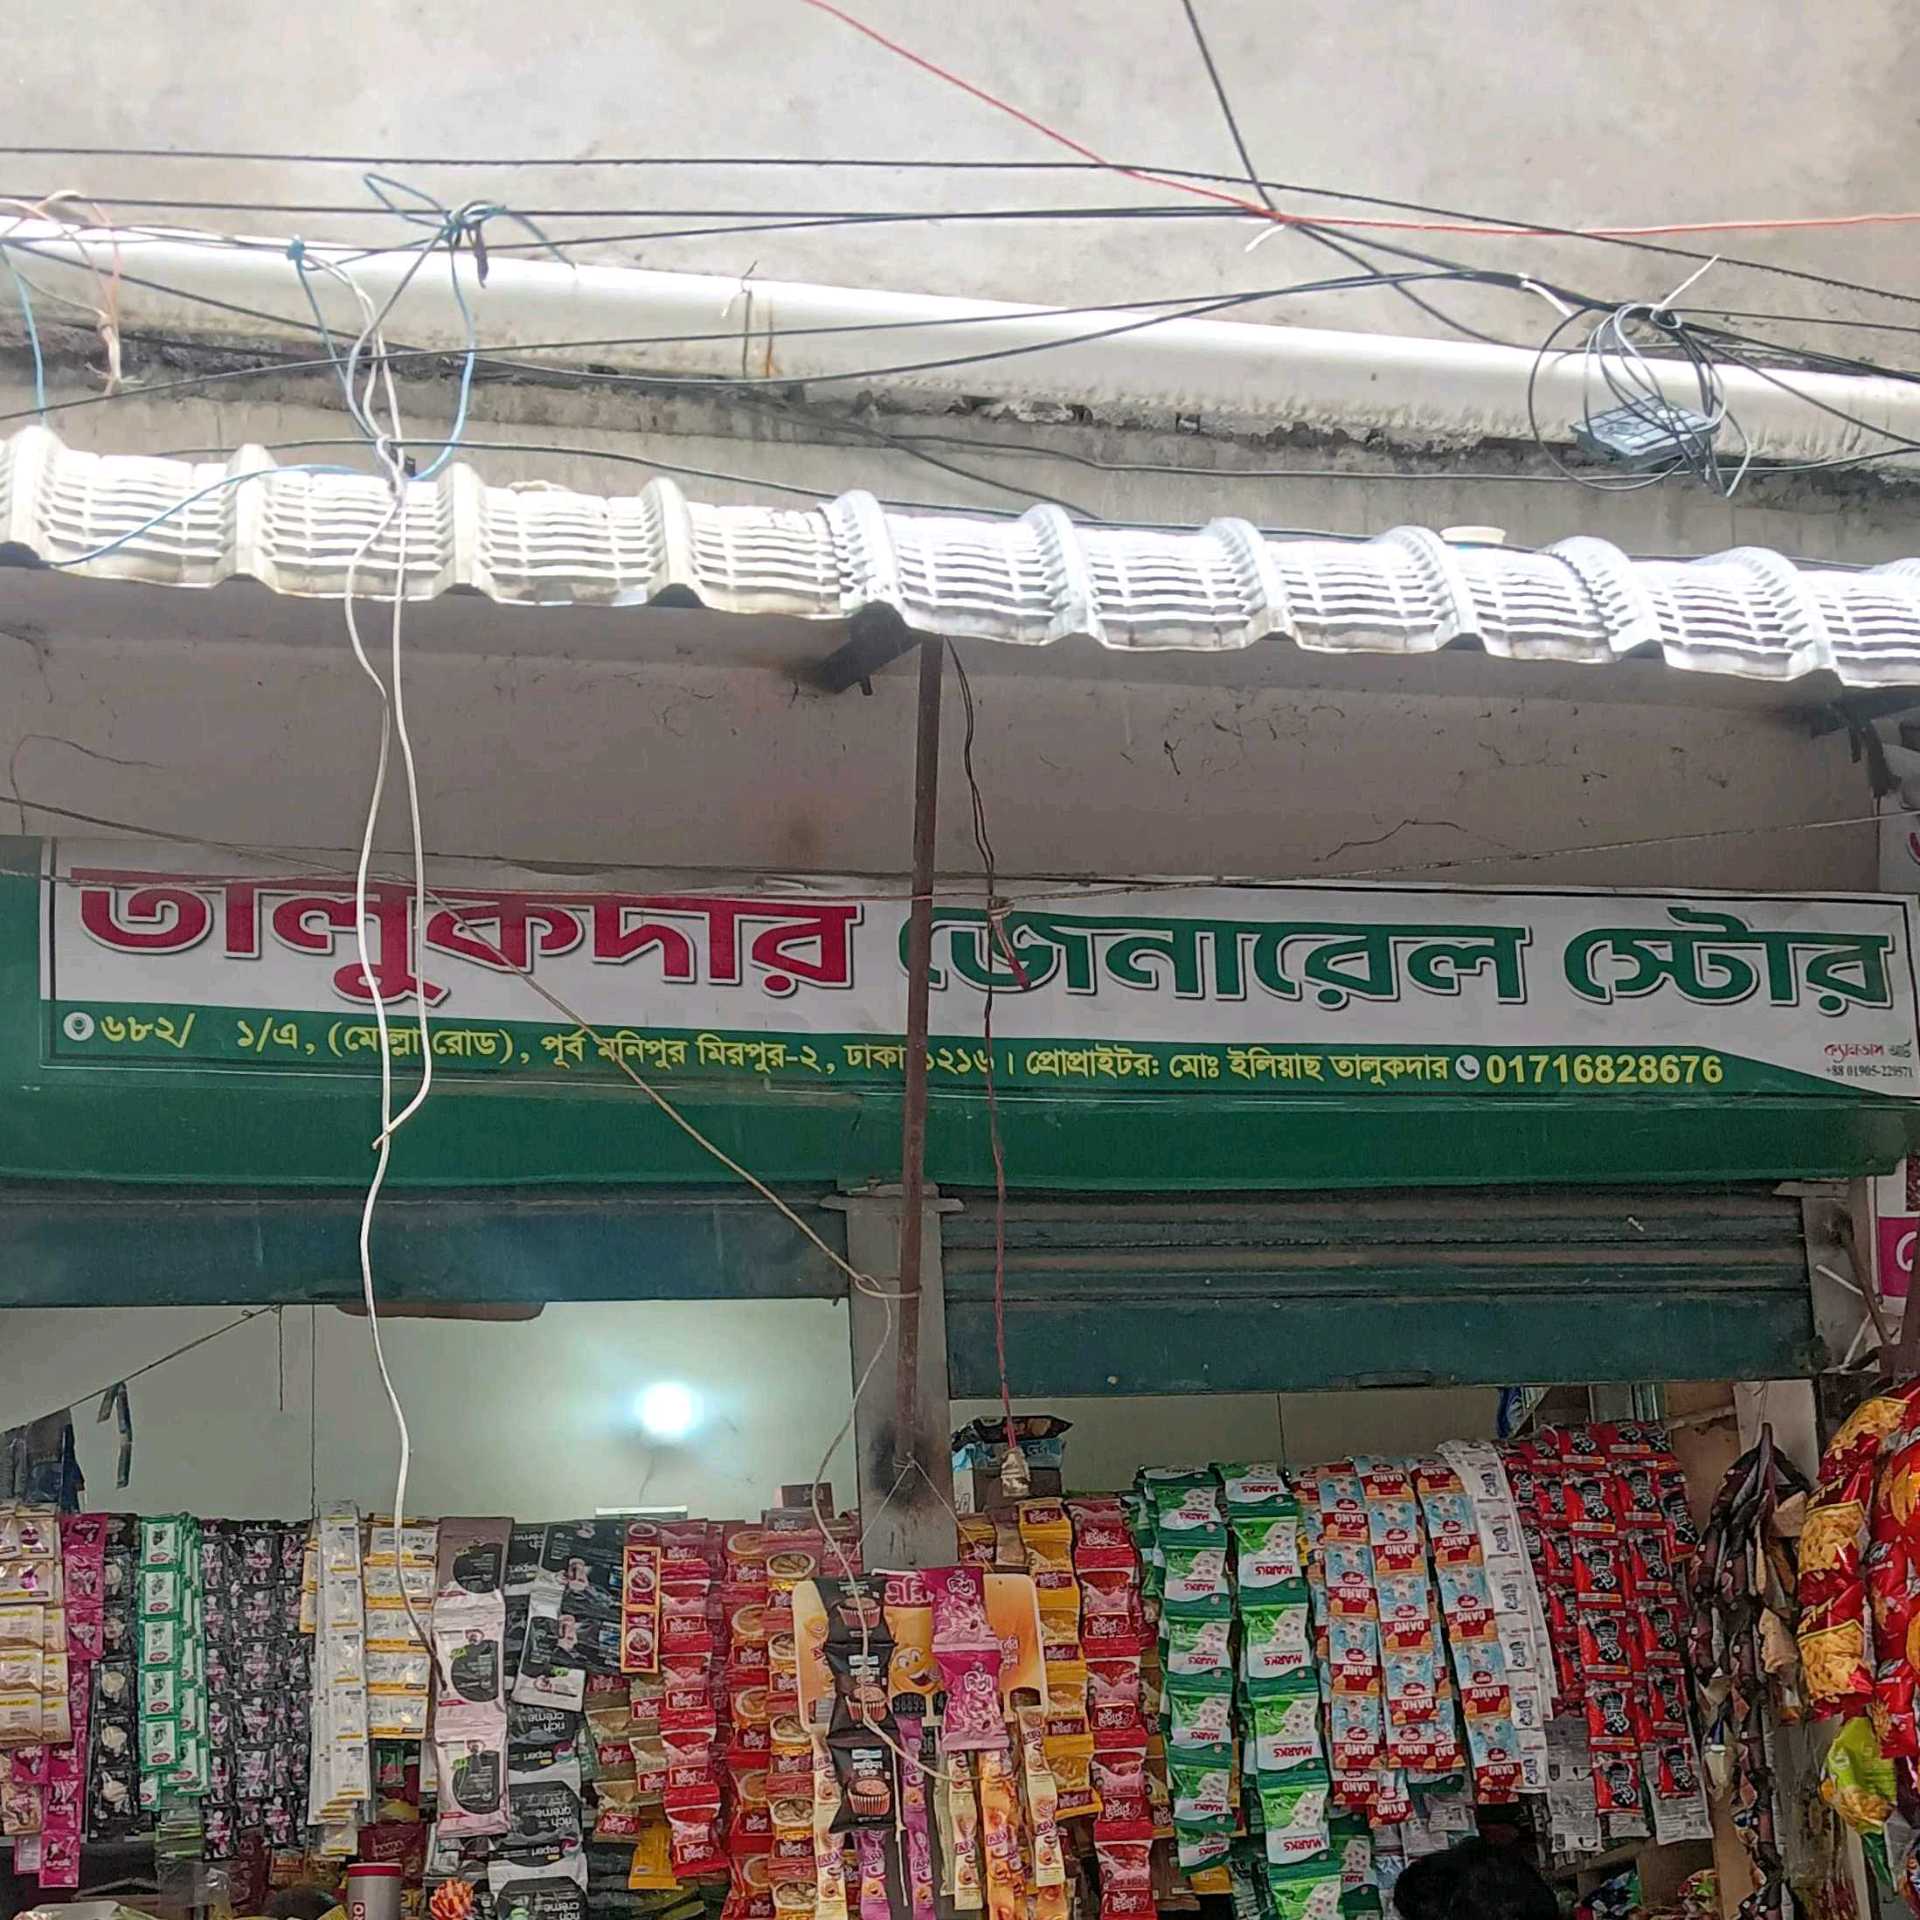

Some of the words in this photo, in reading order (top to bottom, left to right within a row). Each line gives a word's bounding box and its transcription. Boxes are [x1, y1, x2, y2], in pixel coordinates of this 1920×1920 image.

[70, 867, 862, 1006] তালুকদার
[898, 904, 1531, 1011] জেনারেল
[1563, 905, 1894, 1014] স্টোর
[540, 1028, 586, 1069] পূর্ব
[597, 1030, 689, 1070] মনিপুর
[843, 1043, 907, 1070] ঢাকা
[1226, 1046, 1323, 1081] ইলিয়াছ
[1328, 1053, 1449, 1086] তালুকদার
[1486, 1054, 1724, 1084] 01716828676
